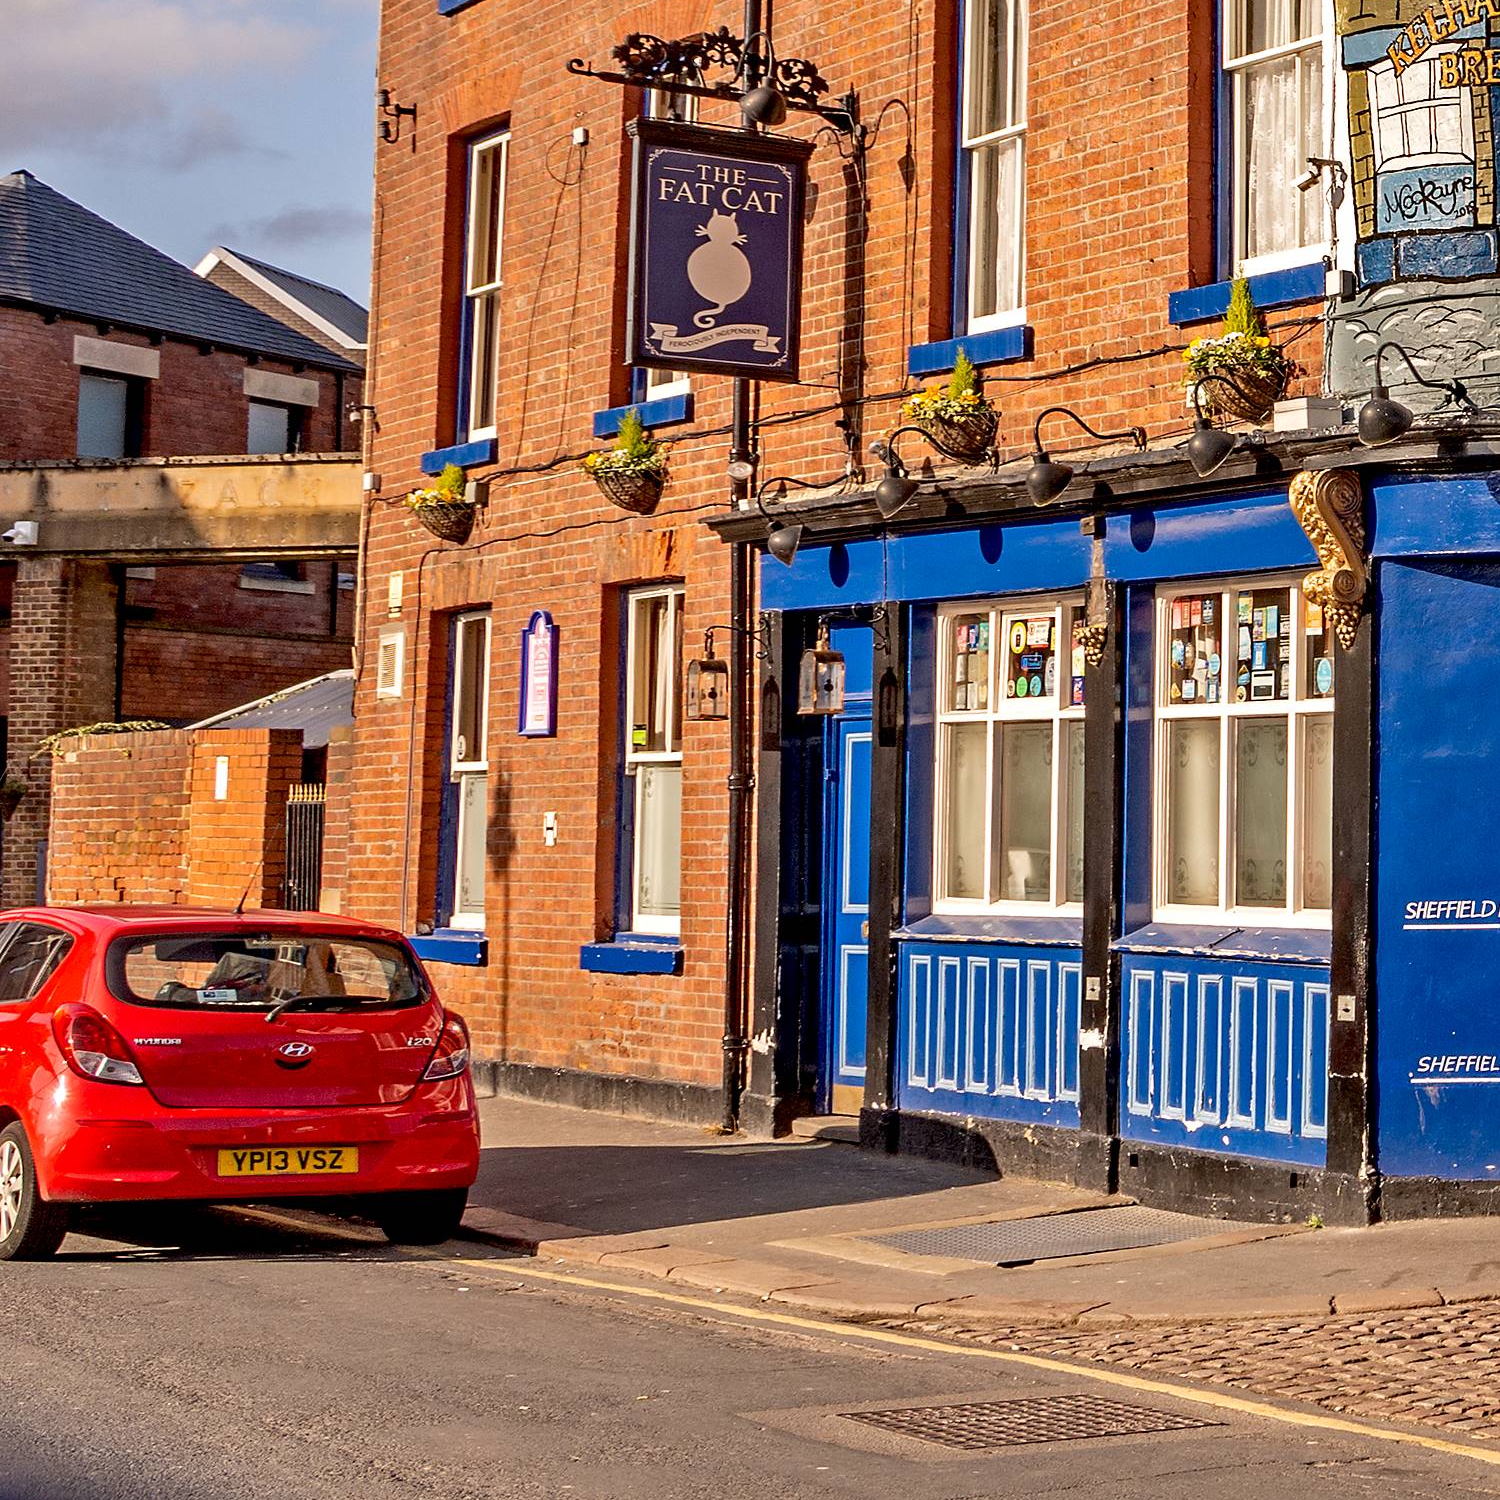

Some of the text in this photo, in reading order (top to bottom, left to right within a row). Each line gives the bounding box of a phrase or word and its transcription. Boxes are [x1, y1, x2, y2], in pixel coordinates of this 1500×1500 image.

[697, 164, 747, 186] THE
[658, 178, 784, 215] FAT CAT
[668, 327, 761, 348] FEROCIOUSLY INDEPENDENT
[1404, 900, 1497, 920] SHEFFIELD
[133, 1035, 432, 1047] HYUNDAI i20
[233, 1149, 343, 1172] YP13 VSZ
